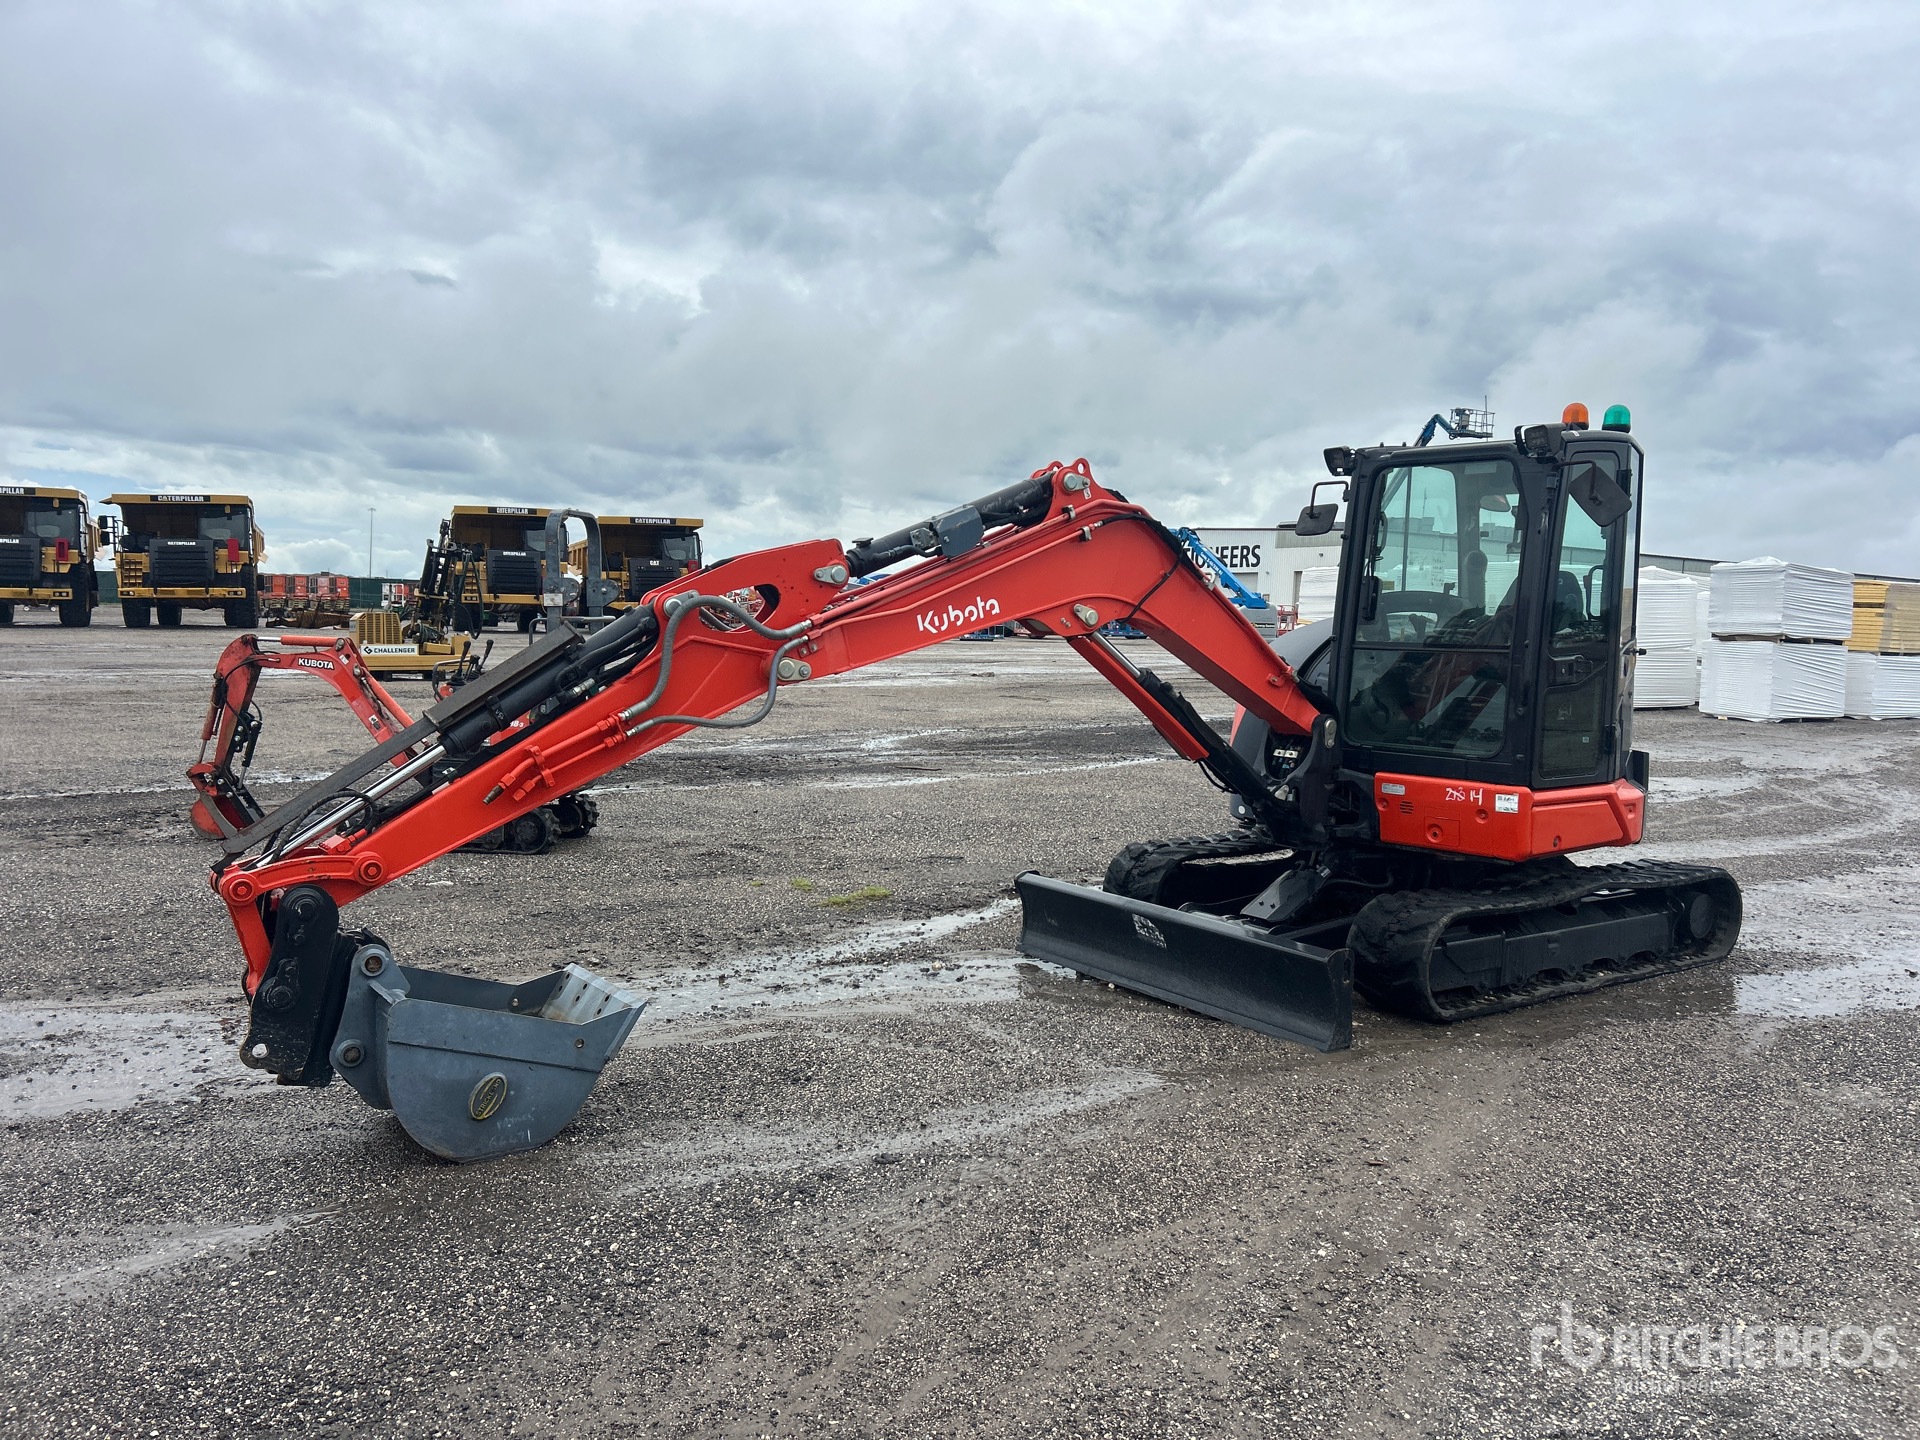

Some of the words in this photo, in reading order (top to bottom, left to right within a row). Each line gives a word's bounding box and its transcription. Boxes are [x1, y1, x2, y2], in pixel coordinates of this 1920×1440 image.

[496, 507, 529, 515] CATERPILLAR
[916, 596, 1000, 634] Kubota
[298, 658, 334, 670] KUBOTA
[1469, 788, 1484, 806] 14
[475, 1078, 501, 1116] STRICKLND
